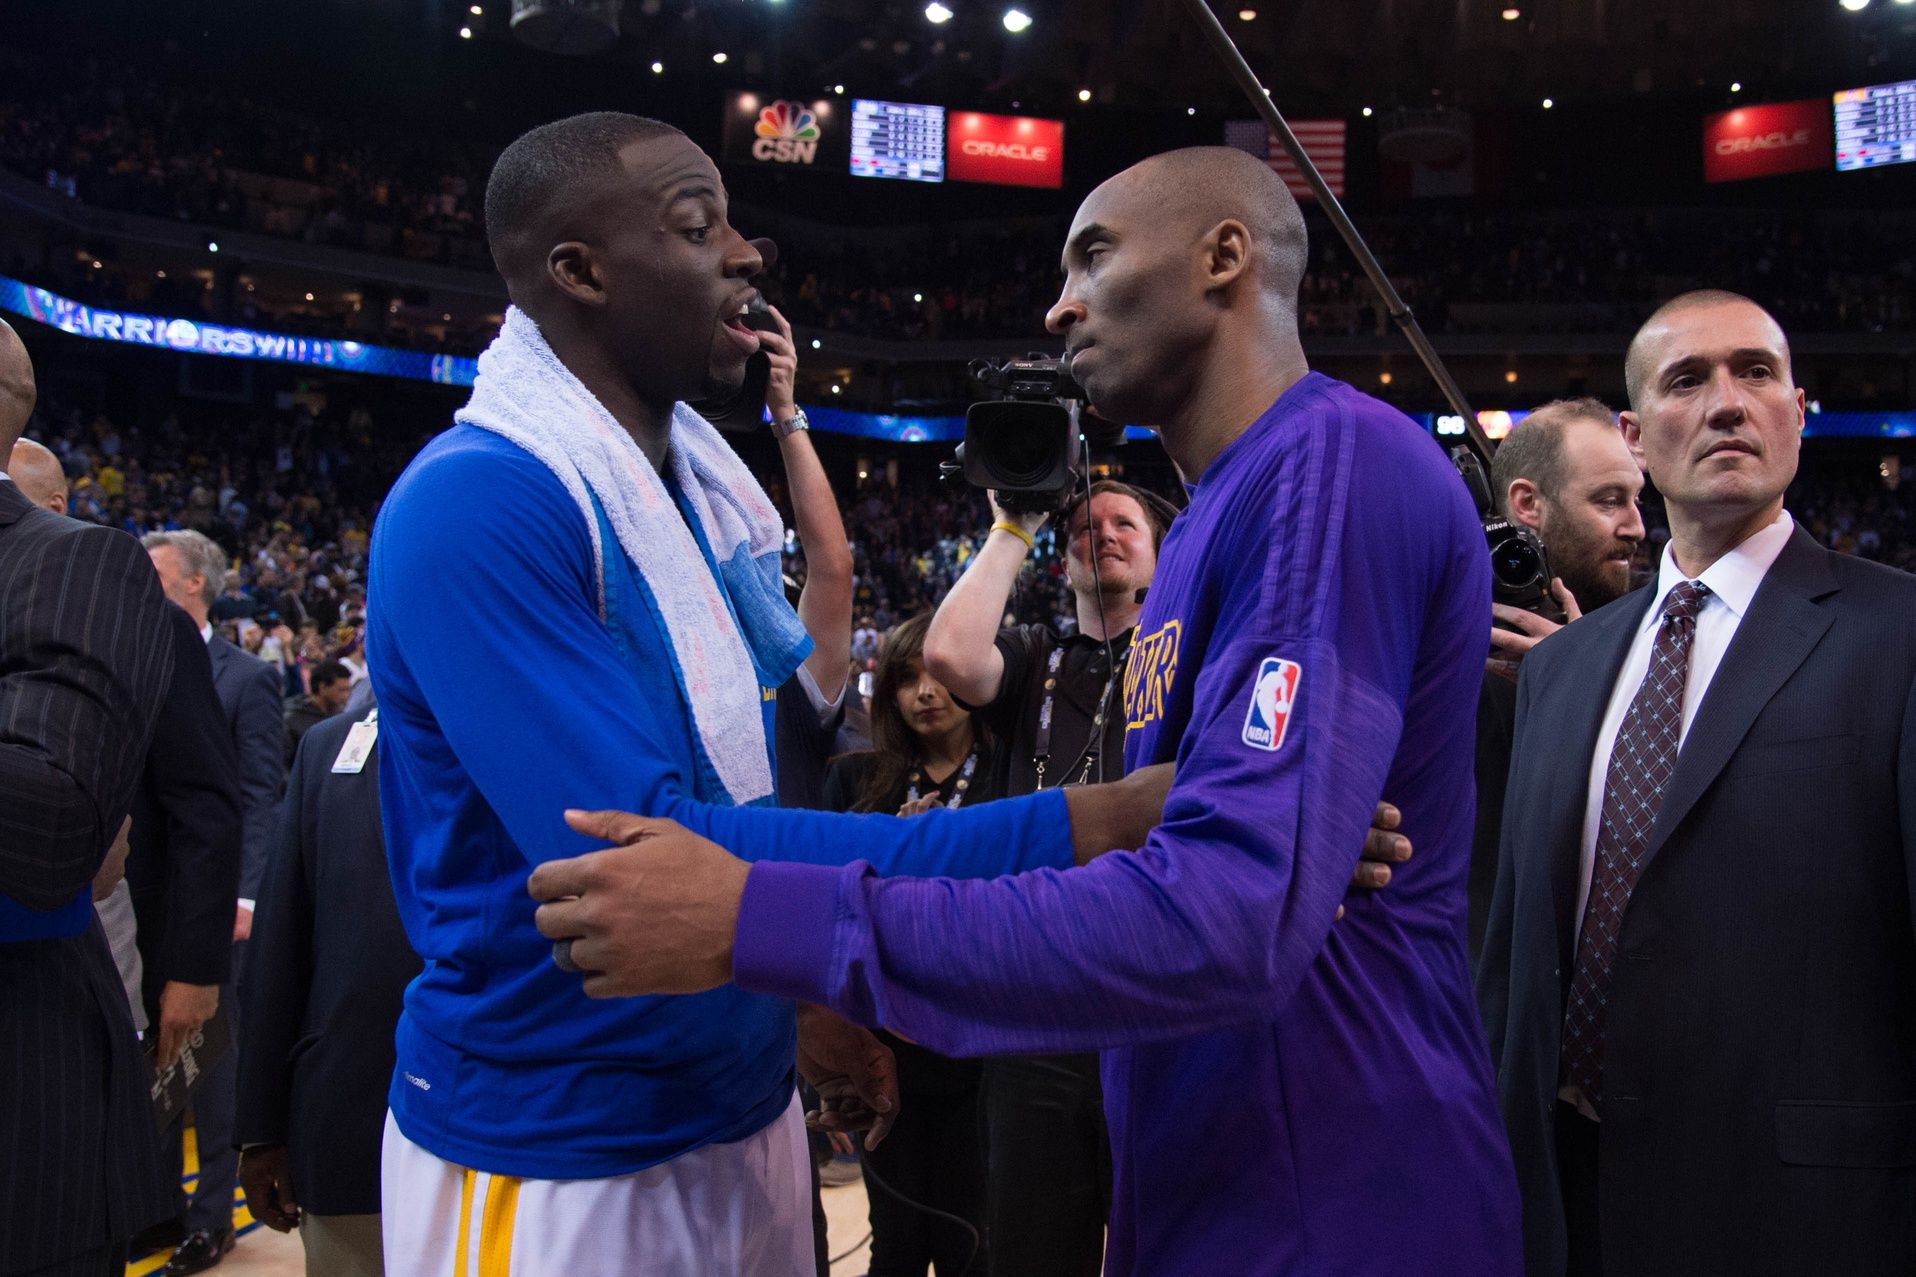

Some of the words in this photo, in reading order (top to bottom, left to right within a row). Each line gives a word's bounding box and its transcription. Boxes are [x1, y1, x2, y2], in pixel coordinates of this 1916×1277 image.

[752, 139, 818, 164] CSN
[962, 140, 1048, 161] ORACLE
[1715, 129, 1811, 156] ORACLE
[1486, 521, 1508, 532] Nikon
[1247, 725, 1269, 743] NBA
